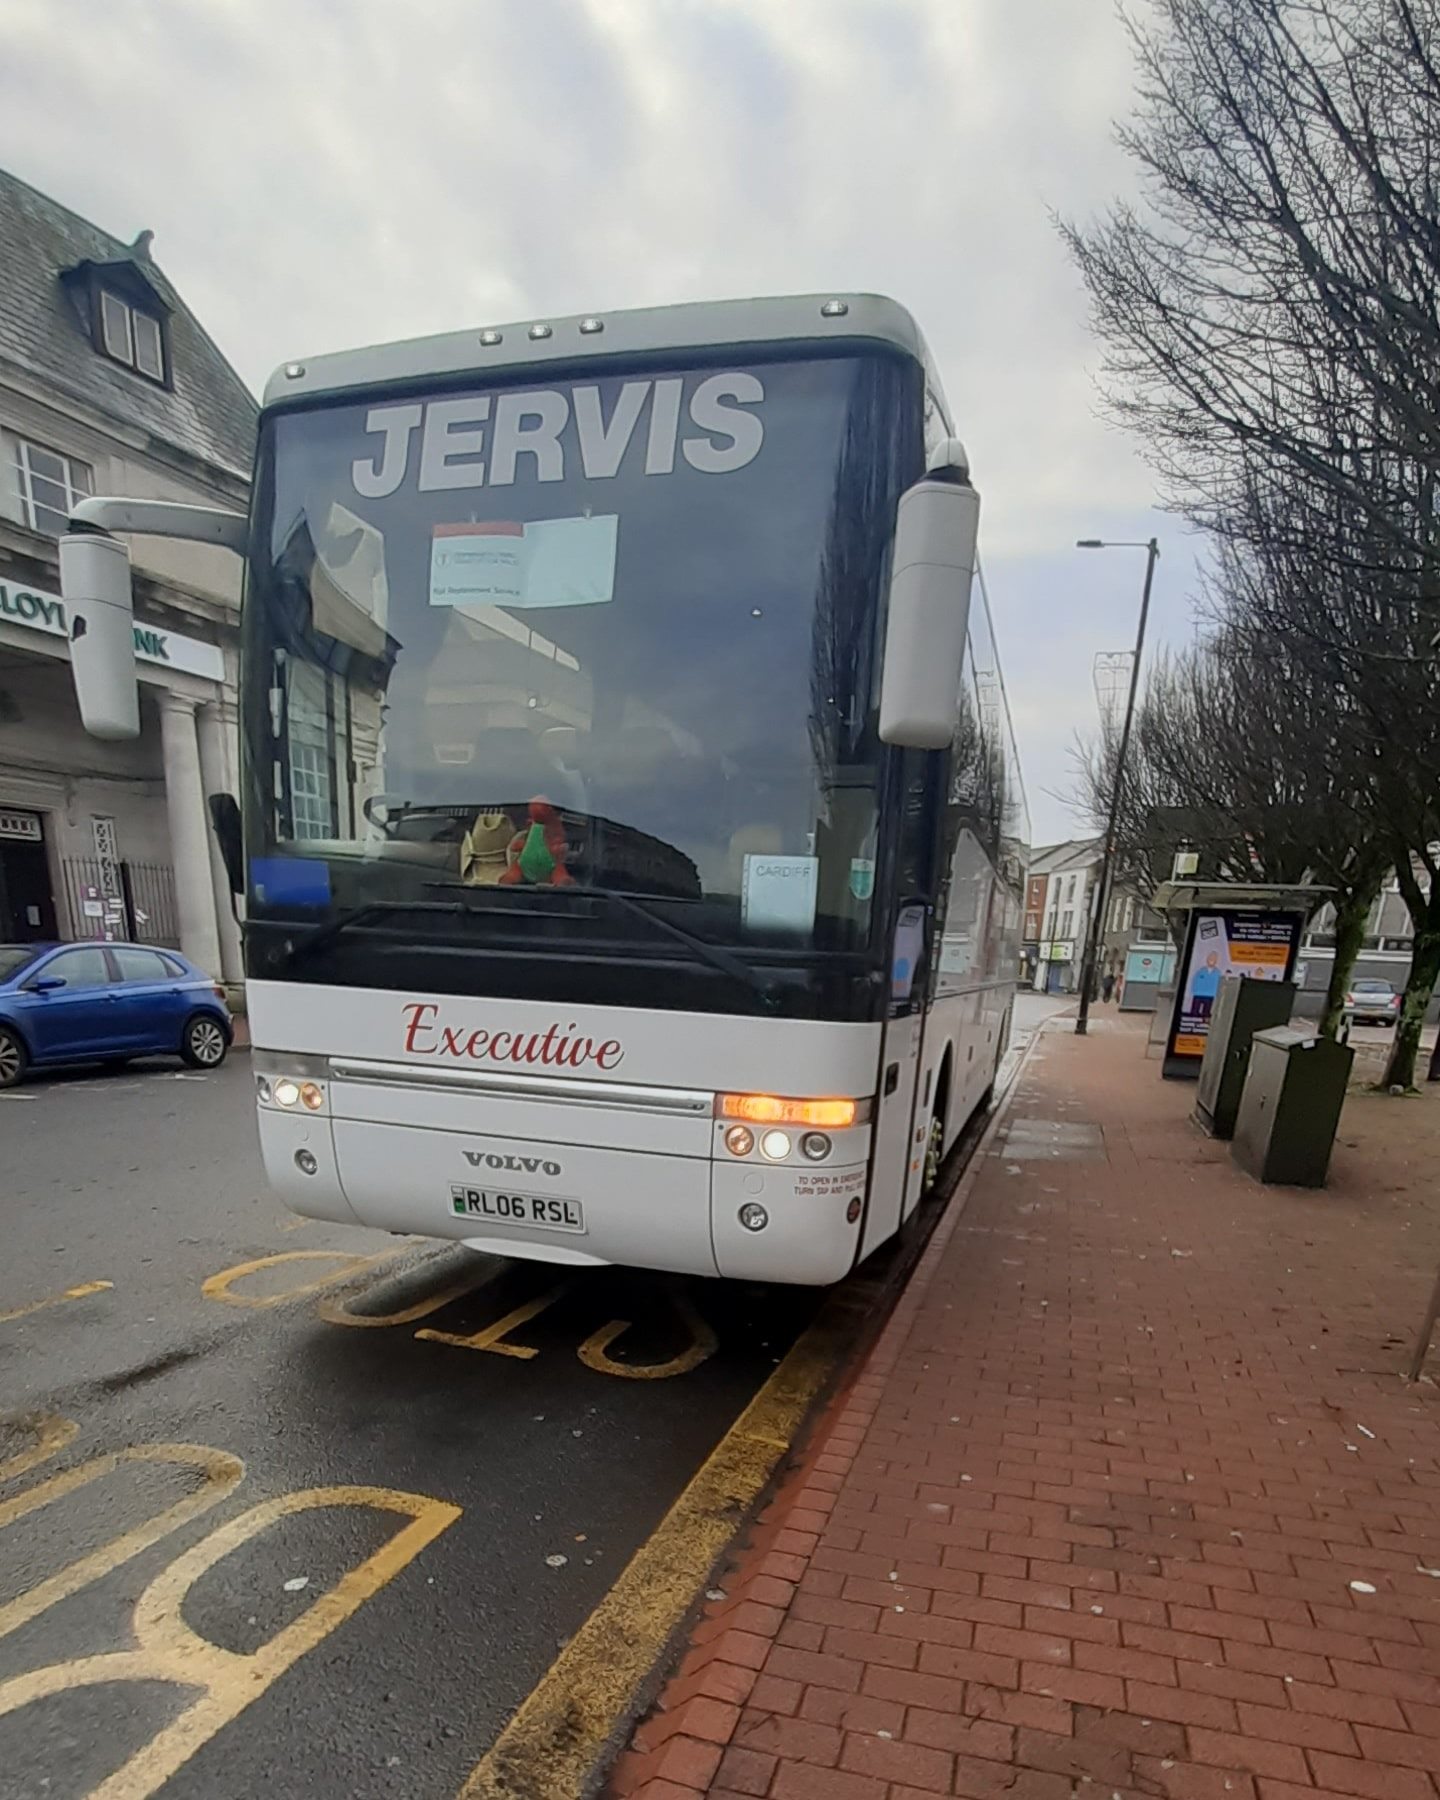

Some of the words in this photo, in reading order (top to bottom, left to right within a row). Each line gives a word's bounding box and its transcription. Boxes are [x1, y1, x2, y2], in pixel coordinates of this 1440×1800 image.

[352, 373, 765, 498] JERVIS
[0, 586, 68, 632] LOY
[132, 628, 170, 660] NK
[756, 865, 811, 878] CARDIFF
[402, 1003, 624, 1070] Executive
[462, 1151, 561, 1176] VOLVO
[467, 1190, 525, 1219] RL06
[532, 1199, 578, 1225] RSL
